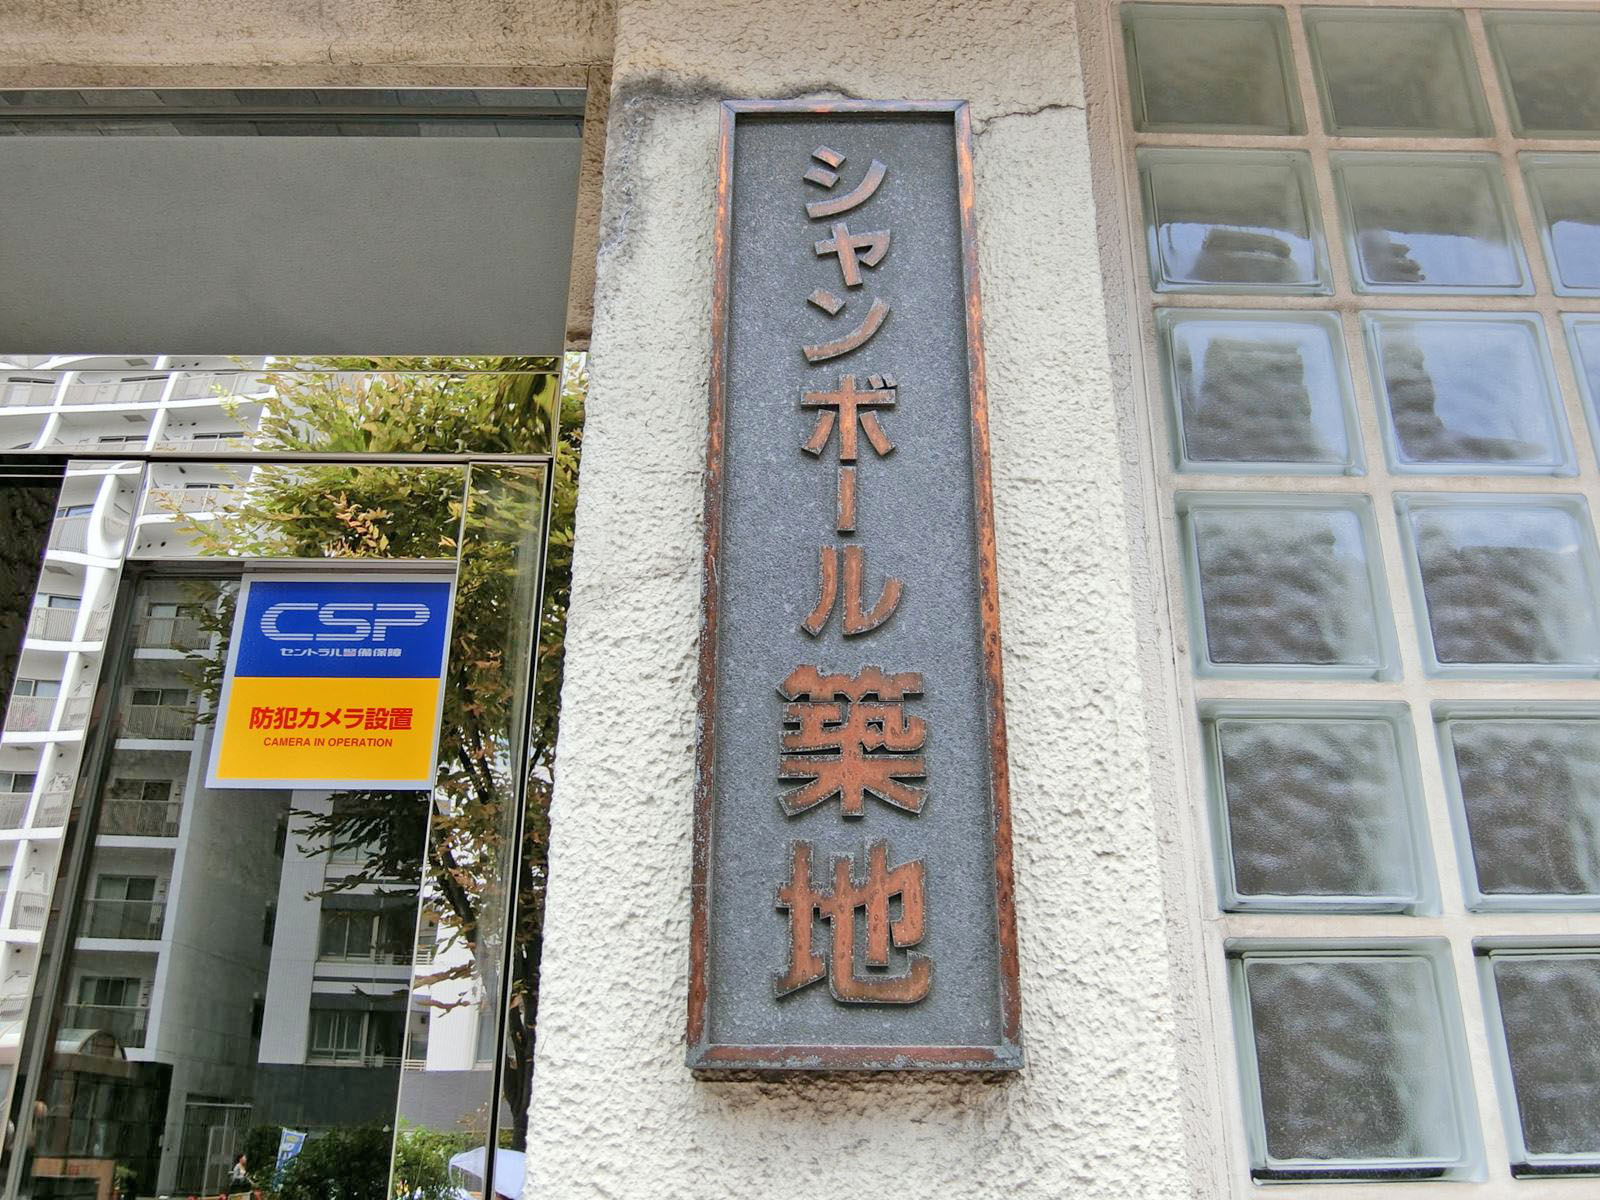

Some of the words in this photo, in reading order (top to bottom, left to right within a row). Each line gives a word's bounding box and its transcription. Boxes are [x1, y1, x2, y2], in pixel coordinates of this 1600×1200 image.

[771, 145, 934, 1005] シャンボール築地
[260, 602, 431, 641] CSP
[279, 647, 403, 657] セントラル警備保障
[249, 707, 413, 730] 防犯カメラ設置
[263, 737, 310, 747] CAMERA
[314, 737, 325, 747] IN
[328, 737, 393, 747] OPERATION
